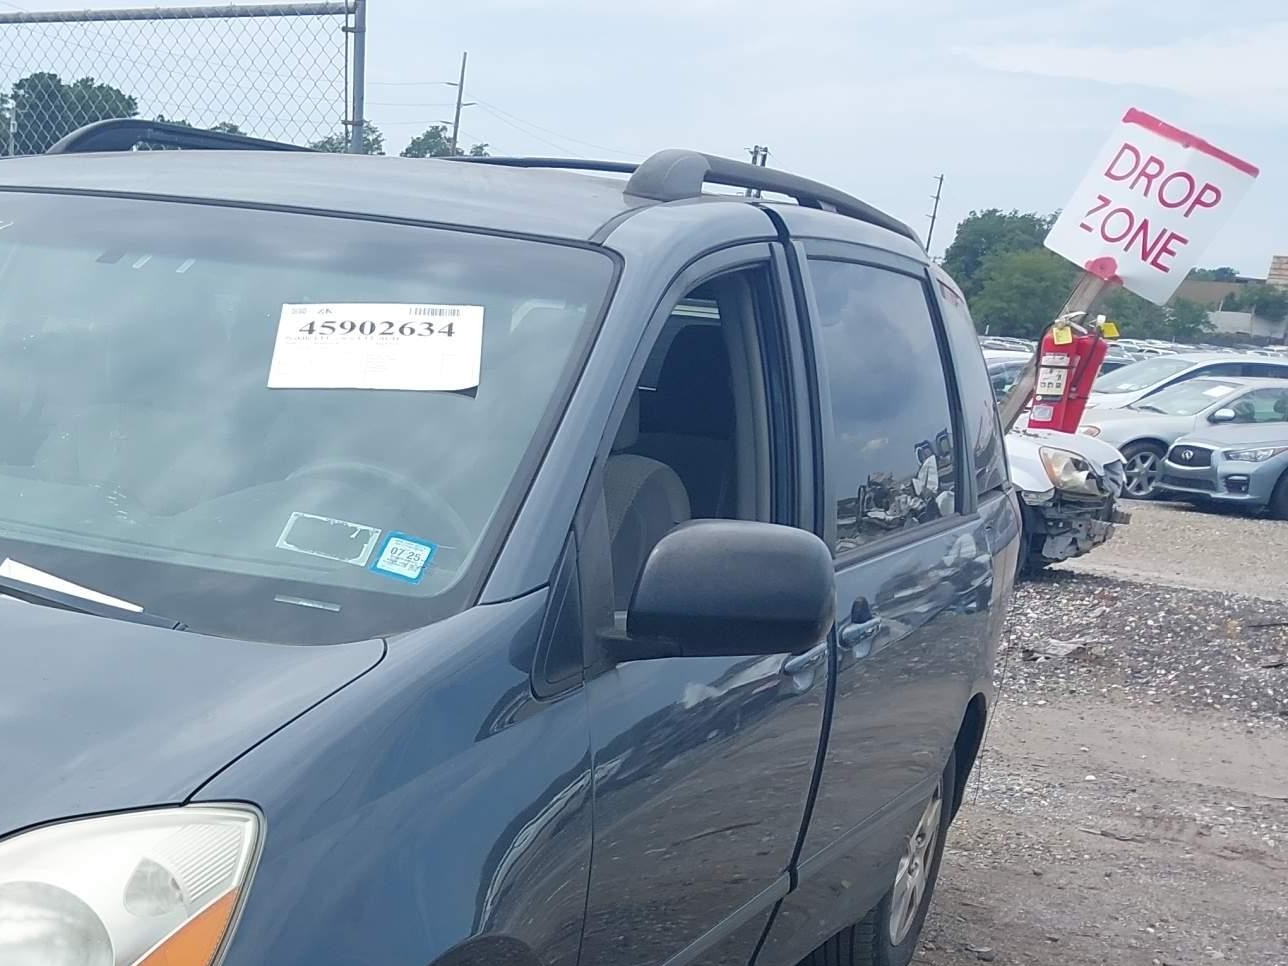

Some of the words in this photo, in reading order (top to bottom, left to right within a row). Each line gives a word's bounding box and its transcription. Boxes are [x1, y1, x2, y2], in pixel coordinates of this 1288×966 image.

[1103, 142, 1222, 218] DROP
[1079, 193, 1189, 274] ZONE
[298, 319, 456, 338] 45902634
